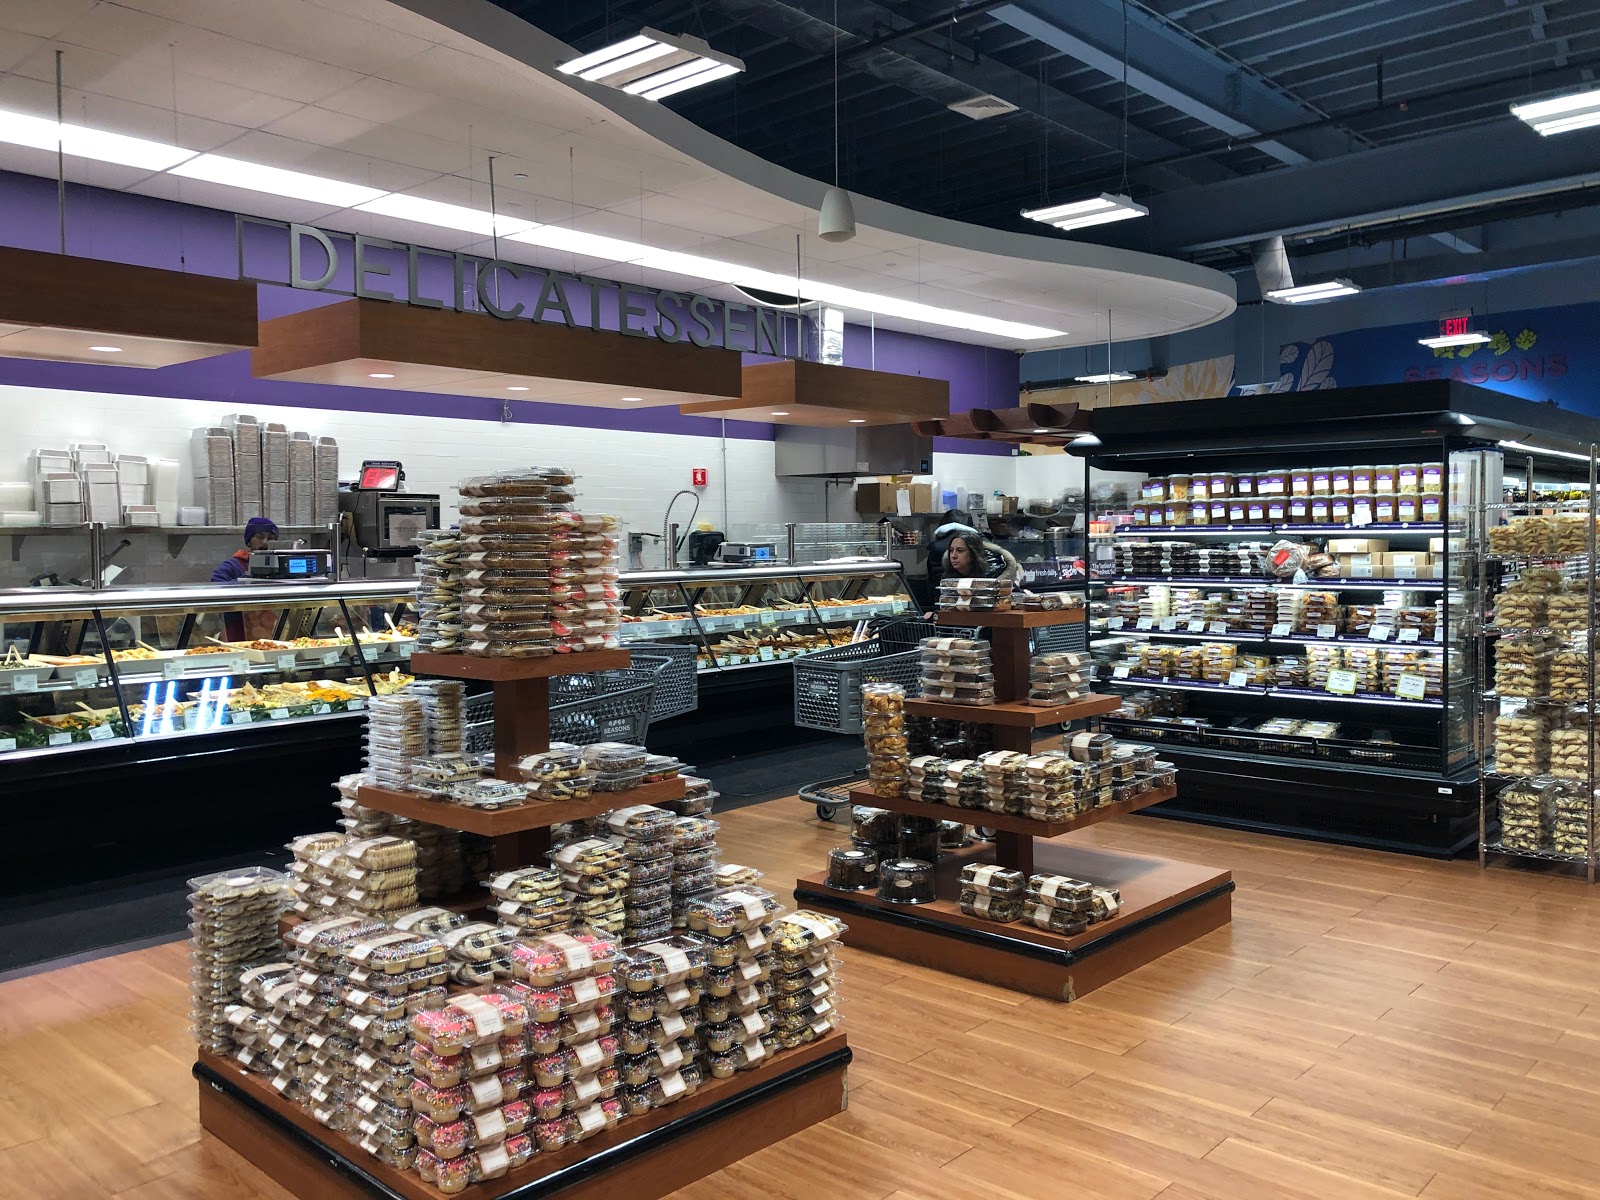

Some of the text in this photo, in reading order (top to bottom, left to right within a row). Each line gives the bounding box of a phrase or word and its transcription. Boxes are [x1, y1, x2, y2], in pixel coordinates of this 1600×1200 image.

[290, 222, 783, 356] DELICATESSEN
[1445, 317, 1468, 336] EXIT
[1405, 354, 1568, 384] SEASONS
[603, 724, 631, 735] SEASONS
